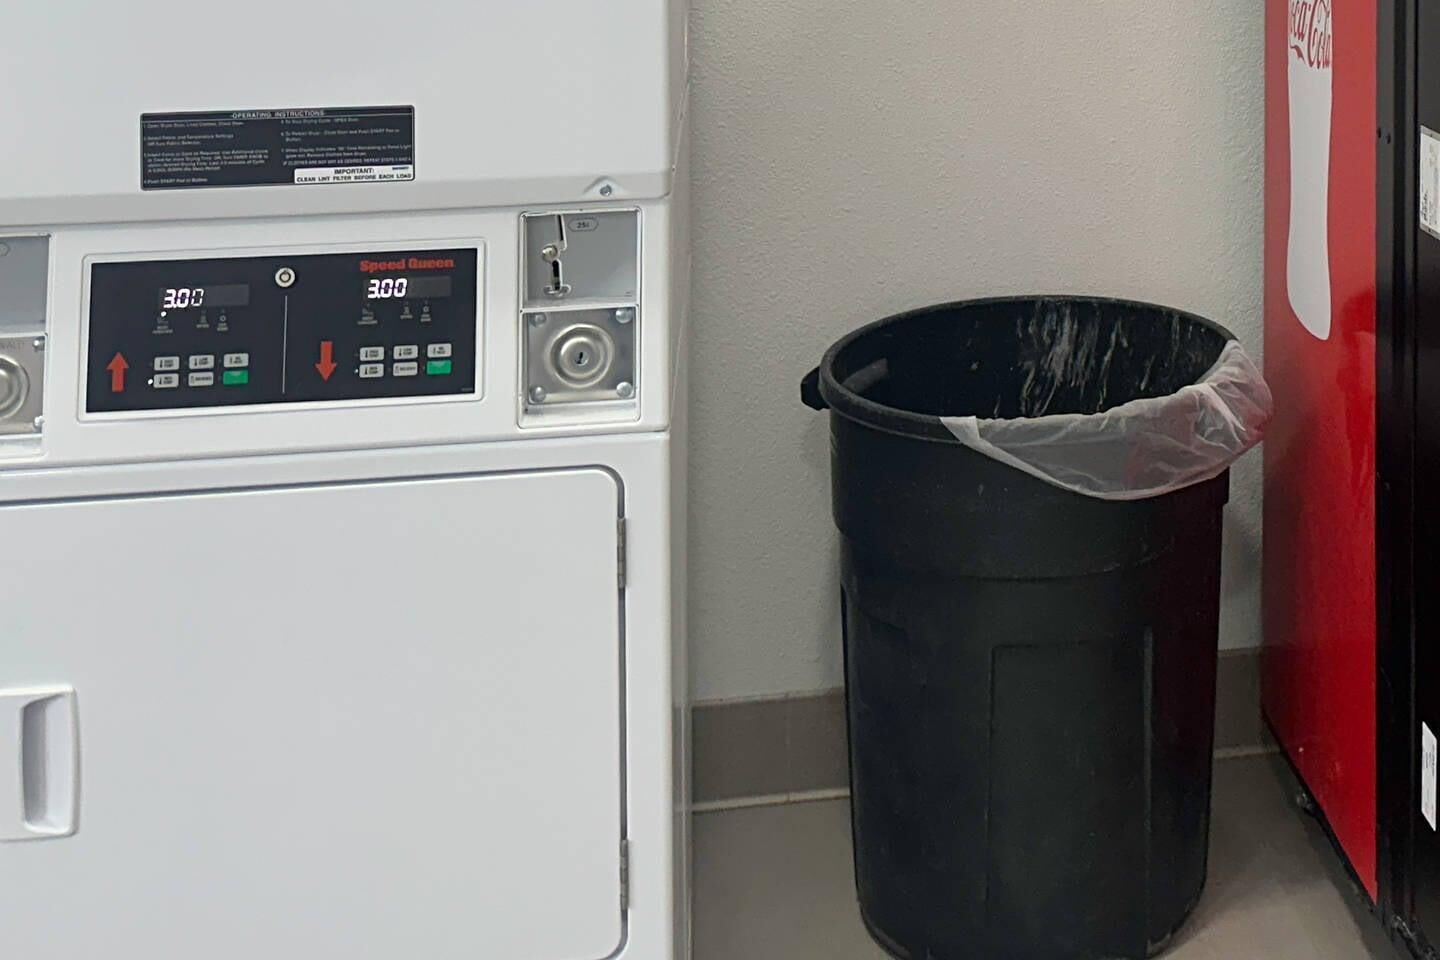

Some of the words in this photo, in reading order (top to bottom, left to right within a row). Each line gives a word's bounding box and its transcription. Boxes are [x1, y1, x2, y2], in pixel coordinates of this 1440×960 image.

[232, 111, 272, 120] OPERATING
[274, 109, 325, 118] INSTRUCTIONS
[360, 259, 406, 273] Speed
[408, 257, 455, 270] Queen
[367, 277, 408, 299] 3.00
[163, 288, 204, 309] 3.00
